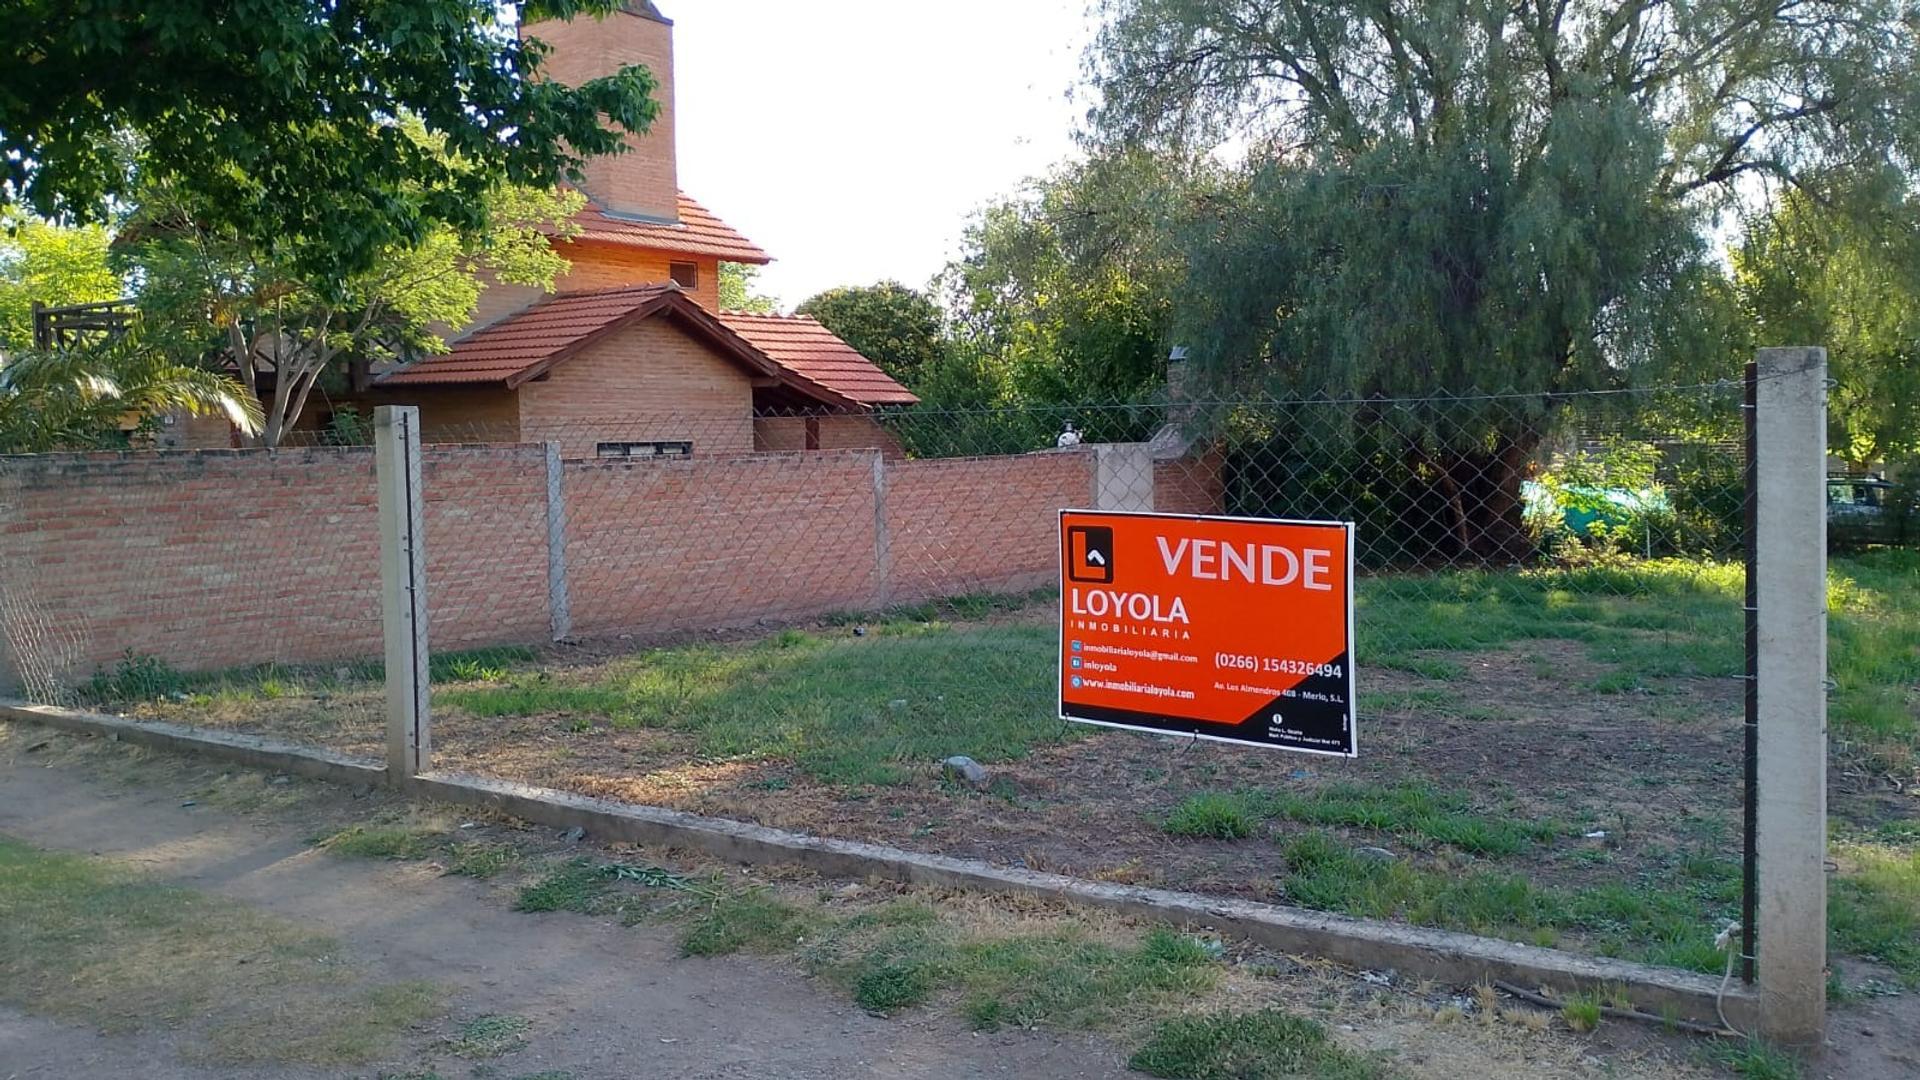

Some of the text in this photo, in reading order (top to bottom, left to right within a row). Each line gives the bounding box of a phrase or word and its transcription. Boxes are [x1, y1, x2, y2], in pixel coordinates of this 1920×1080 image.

[1156, 536, 1332, 591] VENDE
[1072, 588, 1189, 624] LOYOLA
[1070, 620, 1190, 640] INMOBILIARIA
[1083, 643, 1198, 663] inmobiliarialoyola@gmail.com
[1083, 661, 1117, 672] inloyola
[1215, 652, 1343, 679] (0266) 154326494
[1082, 678, 1195, 699] www.inmobiliarialoyola.com
[1226, 683, 1239, 692] Los
[1240, 684, 1281, 697] Almendros
[1302, 691, 1329, 703] Merlo,
